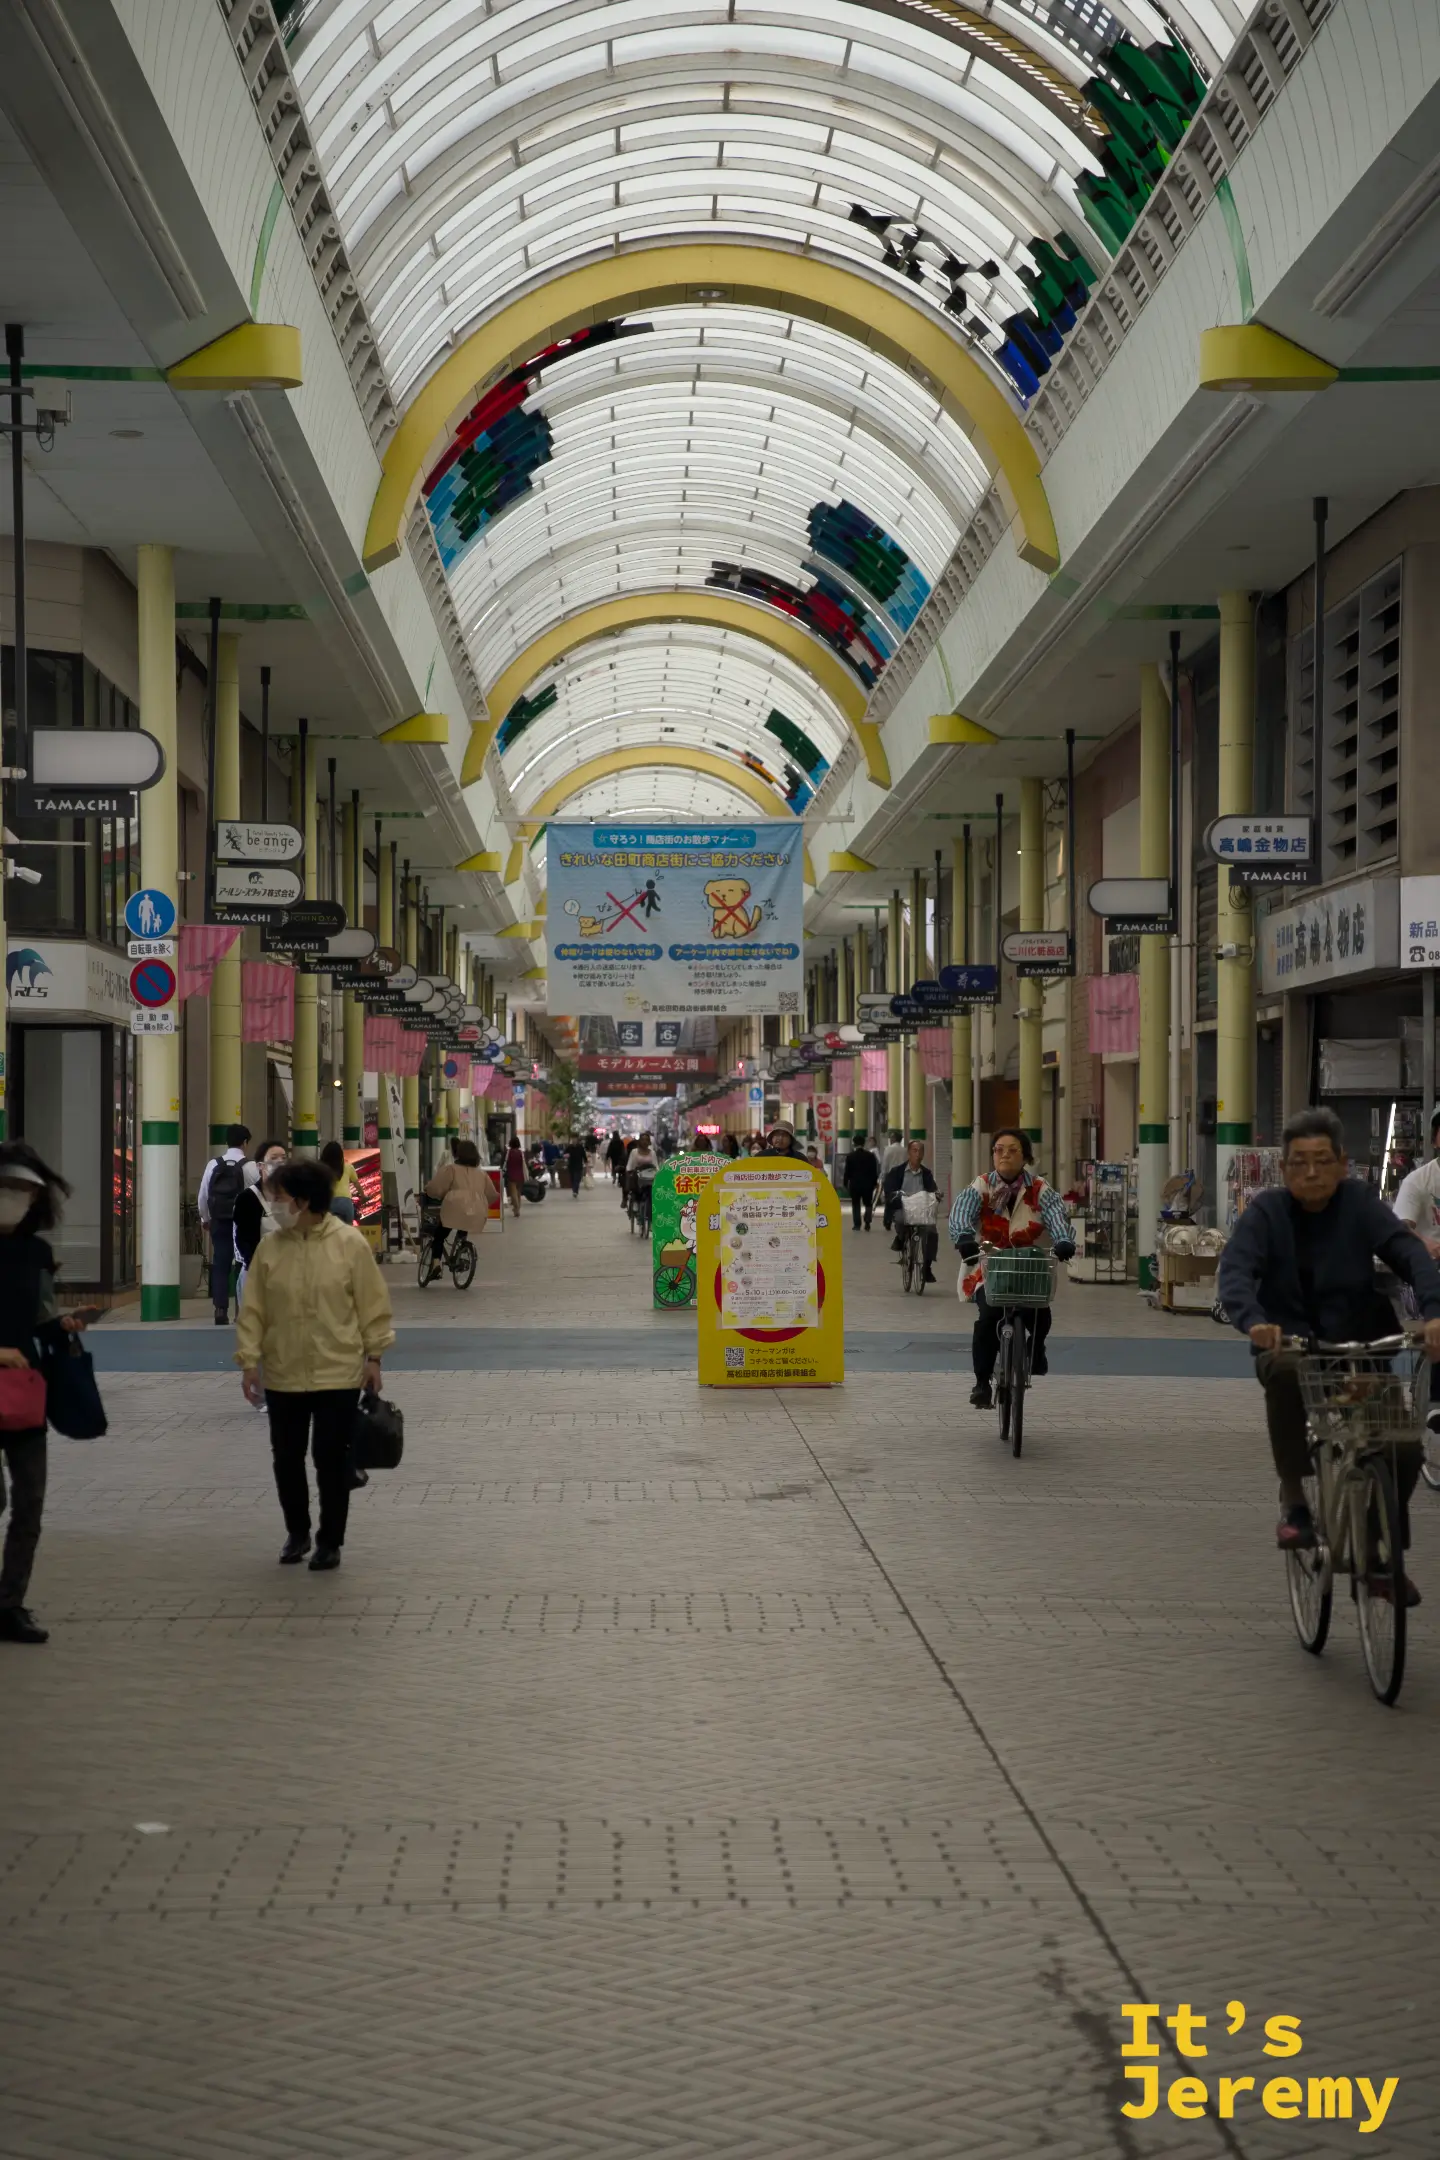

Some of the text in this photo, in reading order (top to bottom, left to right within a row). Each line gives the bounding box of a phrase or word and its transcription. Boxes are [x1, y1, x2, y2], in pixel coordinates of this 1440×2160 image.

[35, 799, 117, 811] TAMACHI
[246, 829, 295, 854] be ange
[560, 852, 790, 868] きれいな田町商店街にご協力ください
[1241, 871, 1307, 881] TAMACHI
[215, 912, 271, 923] TAMACHI
[1115, 923, 1168, 931] TAMACHI
[1409, 921, 1439, 938] 新品
[130, 944, 172, 954] 自転車を除く
[269, 942, 319, 950] TAMACHI
[1008, 946, 1065, 956] 二川化粧品店
[309, 964, 353, 972] TAMACHI
[14, 986, 49, 998] RCS
[136, 1013, 169, 1021] 自動車
[597, 1058, 699, 1070] モデルルーム公開
